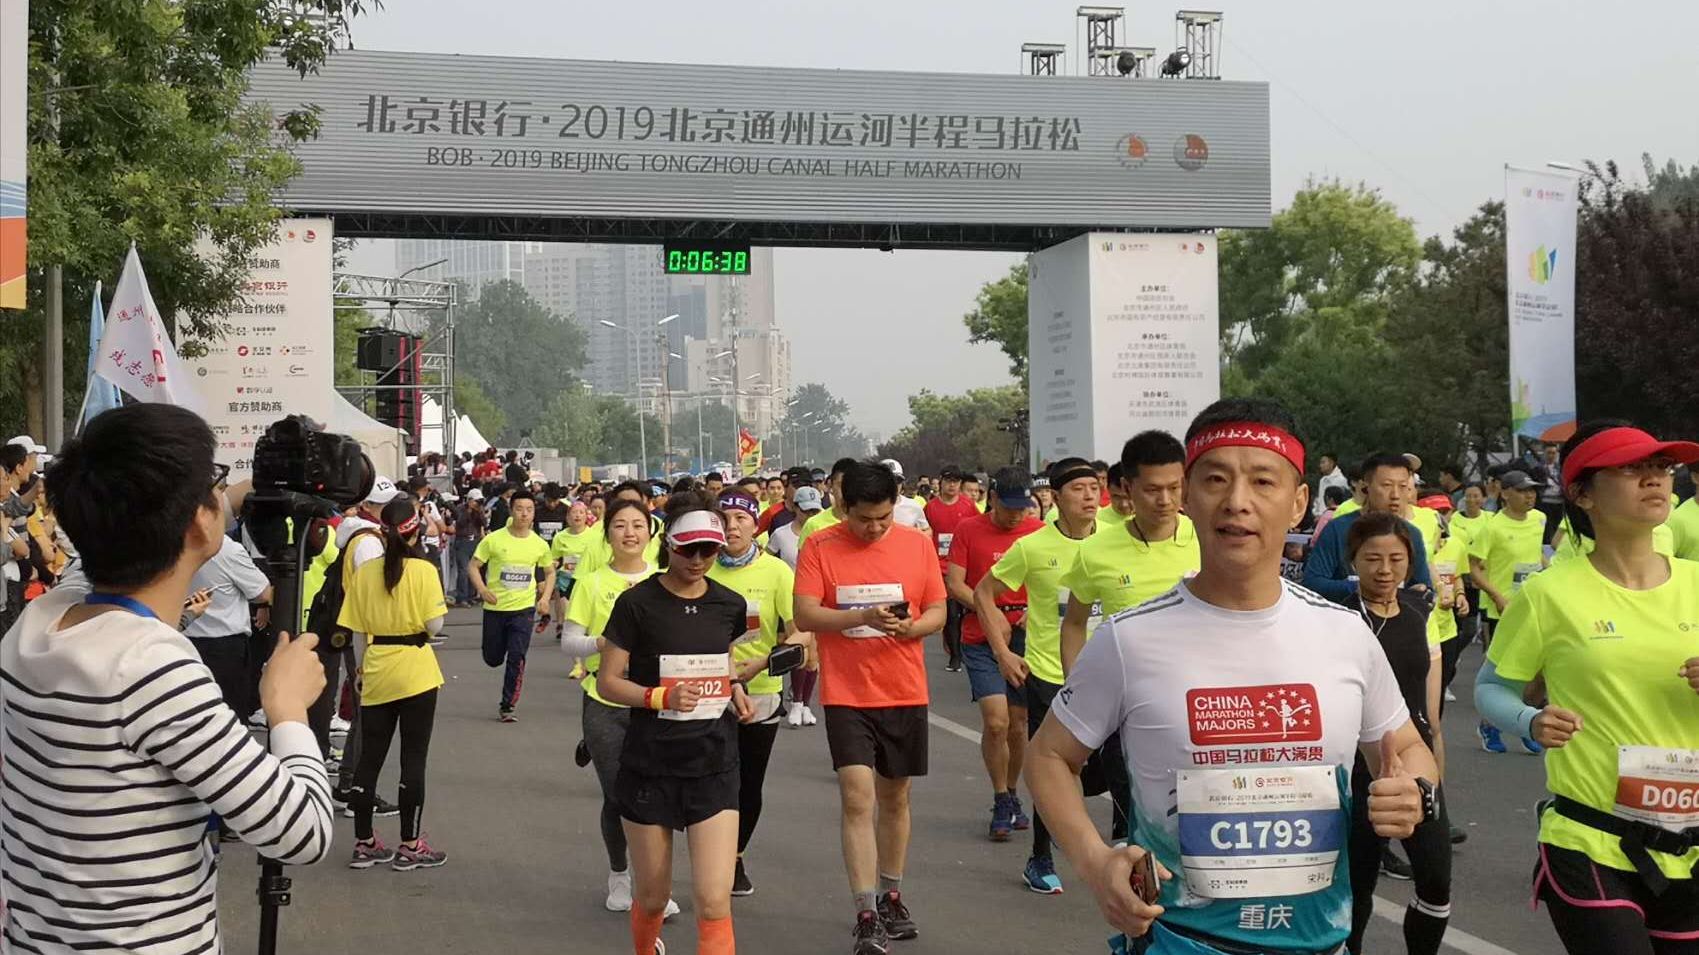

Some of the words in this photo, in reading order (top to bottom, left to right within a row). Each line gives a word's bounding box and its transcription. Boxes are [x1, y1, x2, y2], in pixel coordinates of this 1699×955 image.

[489, 148, 543, 170] 2019
[550, 150, 630, 173] BEIJING
[640, 153, 760, 175] TONGZHOU
[767, 157, 836, 177] CANAL
[844, 159, 897, 178] HALF
[903, 160, 1023, 180] MARATHON
[669, 250, 747, 272] 0:06:38
[228, 401, 282, 412] 官方赞助商
[1194, 695, 1253, 710] CHINA
[1195, 709, 1255, 719] MARATHON
[1196, 719, 1256, 731] MAJORS
[1192, 746, 1323, 765] 中国马拉松大满贯
[1210, 819, 1313, 850] C1793
[1238, 904, 1294, 930] 重庆
